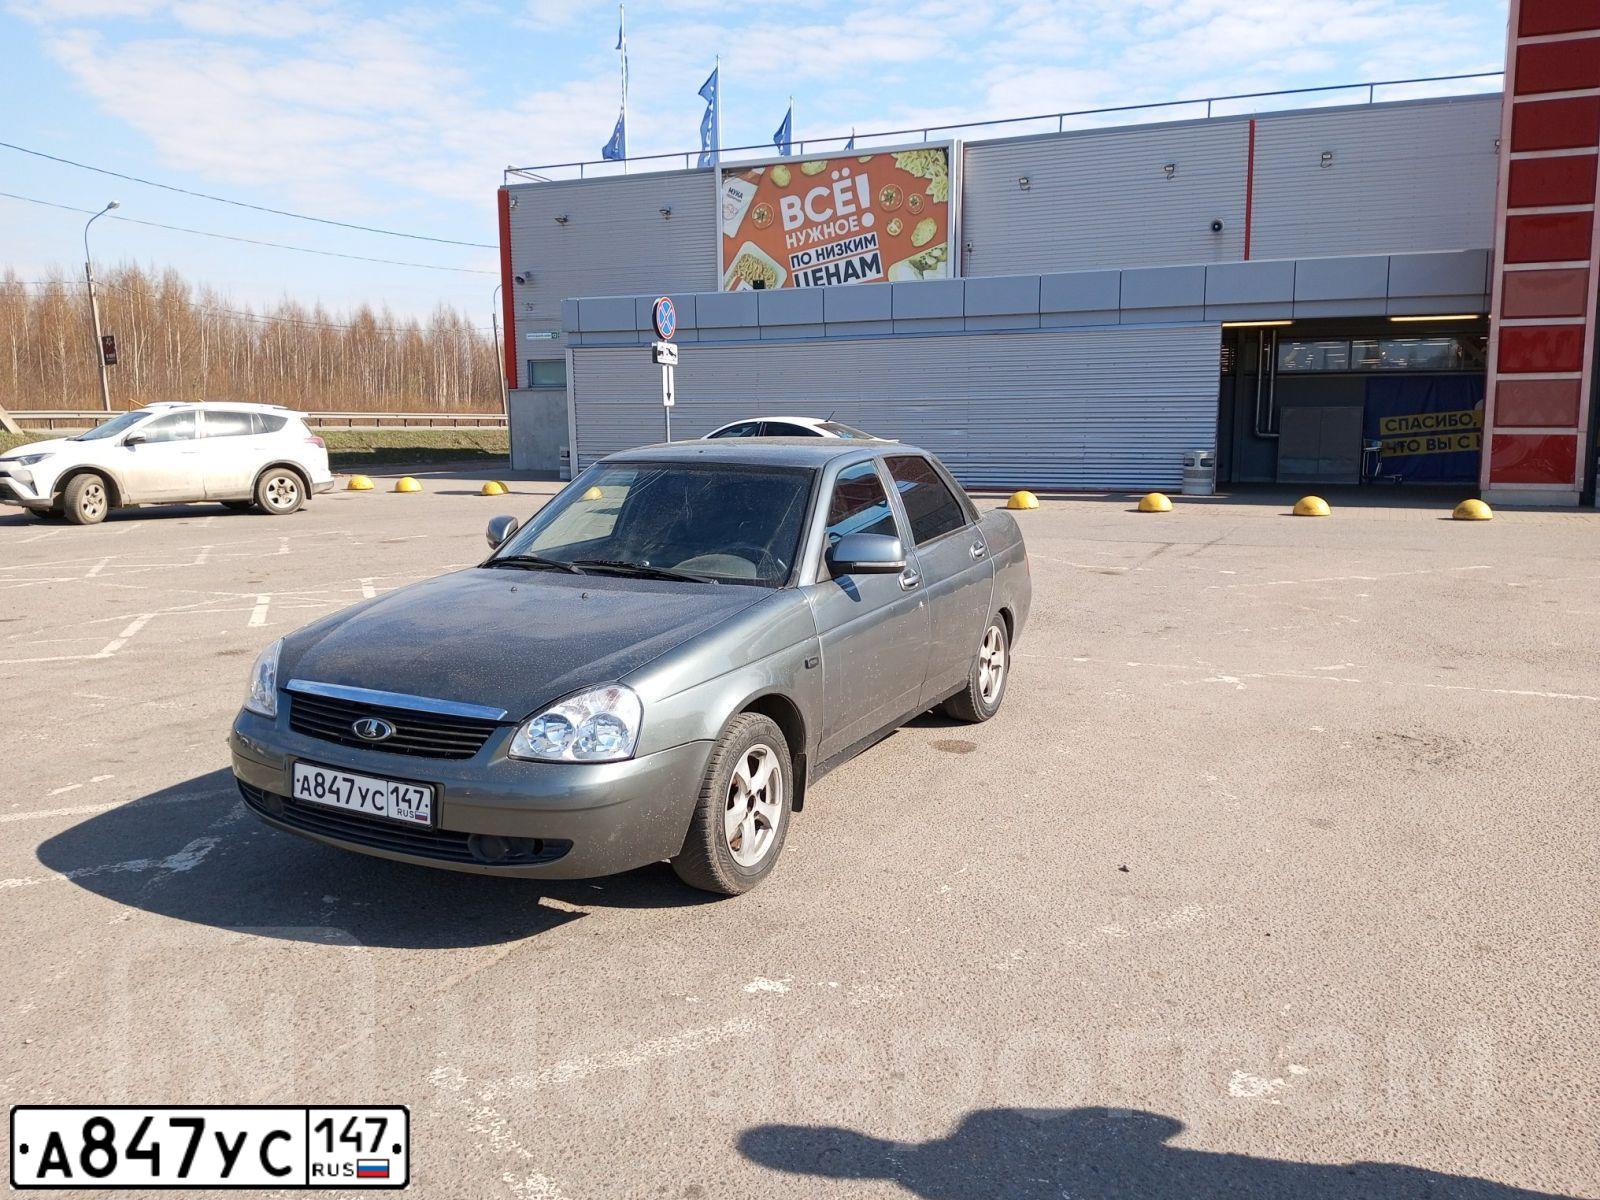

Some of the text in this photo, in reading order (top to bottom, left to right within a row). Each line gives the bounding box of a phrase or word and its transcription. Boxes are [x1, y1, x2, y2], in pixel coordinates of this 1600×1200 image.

[779, 167, 875, 231] ВСЁ!
[785, 216, 859, 249] НУЖНОЕ
[791, 234, 877, 268] ПО НИЗКИМ
[794, 252, 881, 288] ЦЕНАМ
[1385, 413, 1477, 431] СПАСИБО,
[1386, 440, 1420, 453] ЧТО
[1426, 437, 1451, 450] ВЫ
[1458, 435, 1470, 448] С
[300, 772, 424, 811] А847УС 147
[397, 808, 415, 818] RUS
